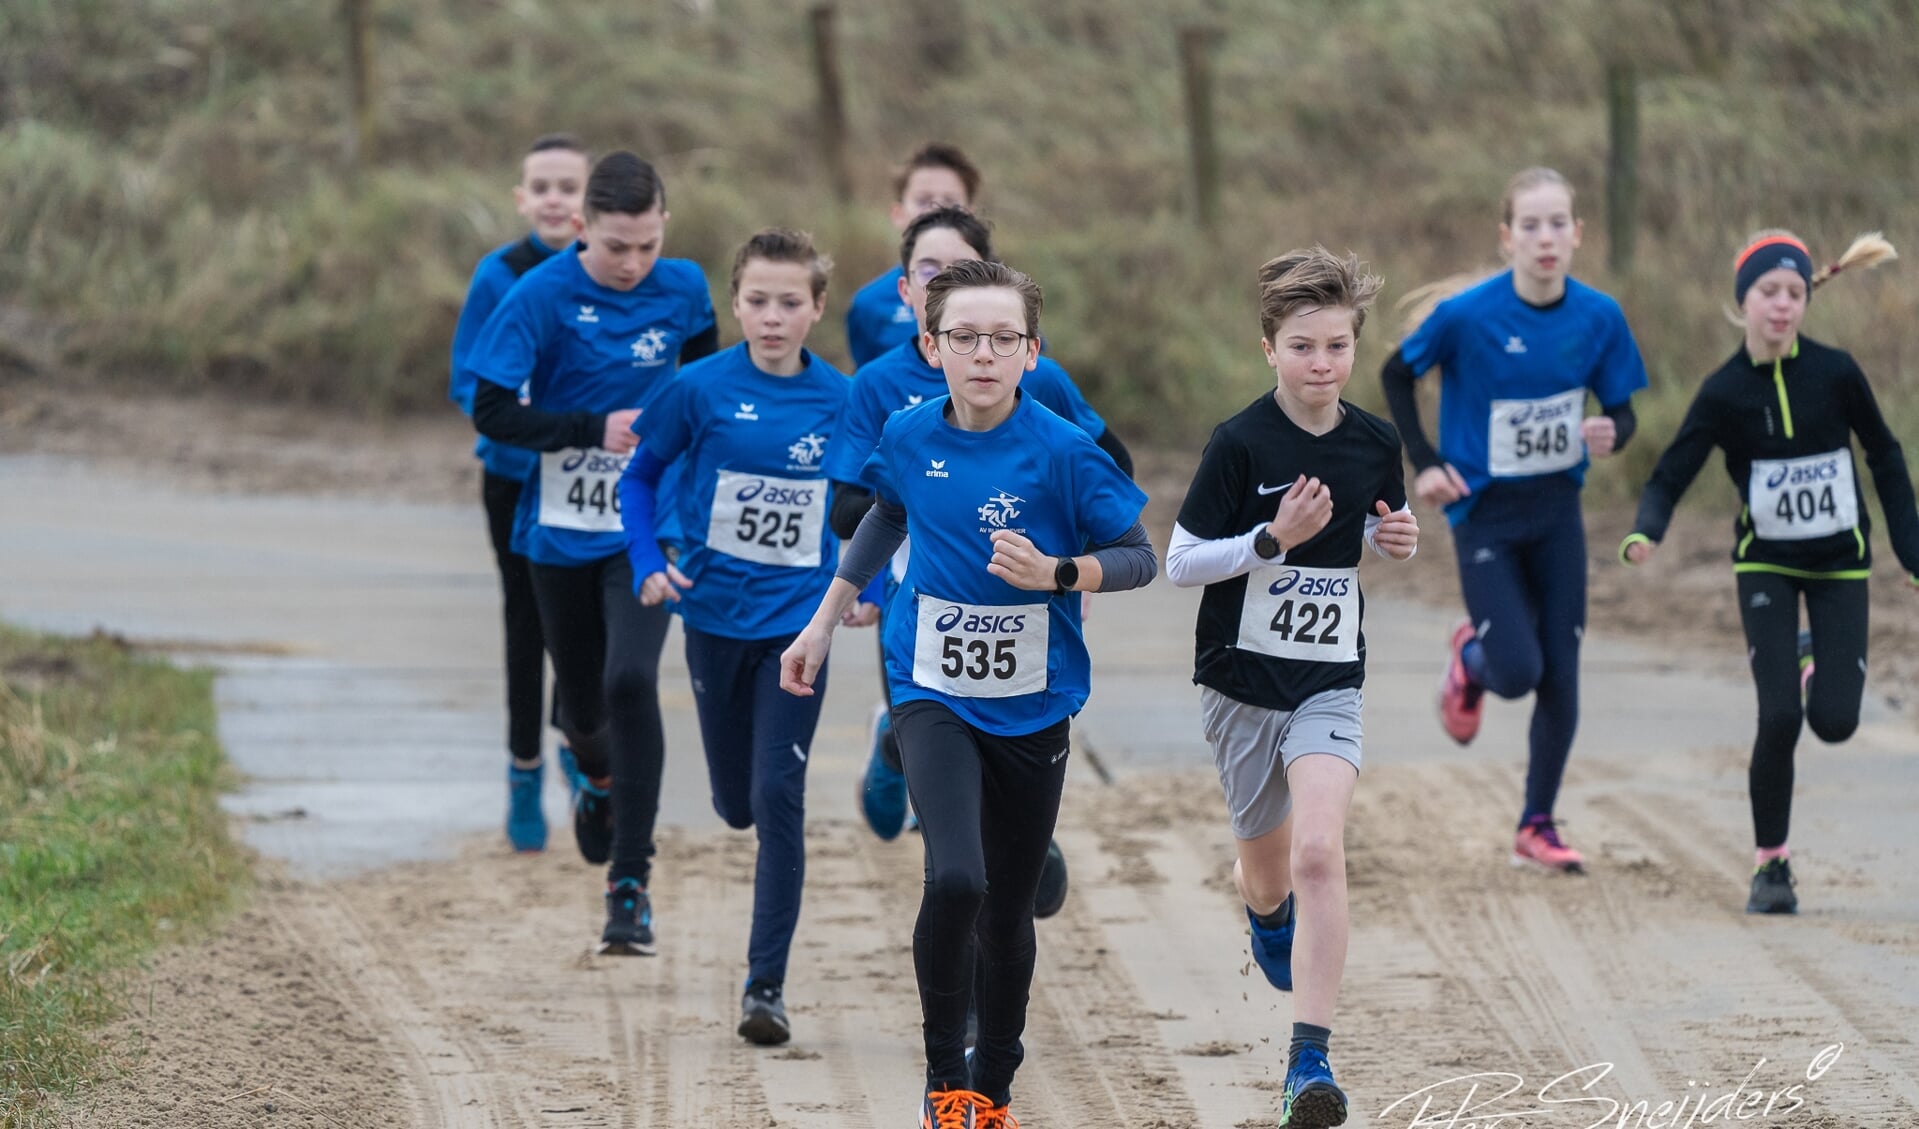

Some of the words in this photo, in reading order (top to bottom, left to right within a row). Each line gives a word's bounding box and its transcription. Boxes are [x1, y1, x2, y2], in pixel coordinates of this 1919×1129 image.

[1515, 424, 1569, 459] 548
[925, 470, 949, 478] erima
[1790, 460, 1838, 484] asics
[763, 486, 815, 506] asics
[1776, 484, 1837, 525] 404
[736, 506, 804, 549] 525
[1298, 577, 1350, 597] asics
[963, 614, 1026, 633] asics
[1269, 599, 1342, 645] 422
[941, 635, 1017, 681] 535
